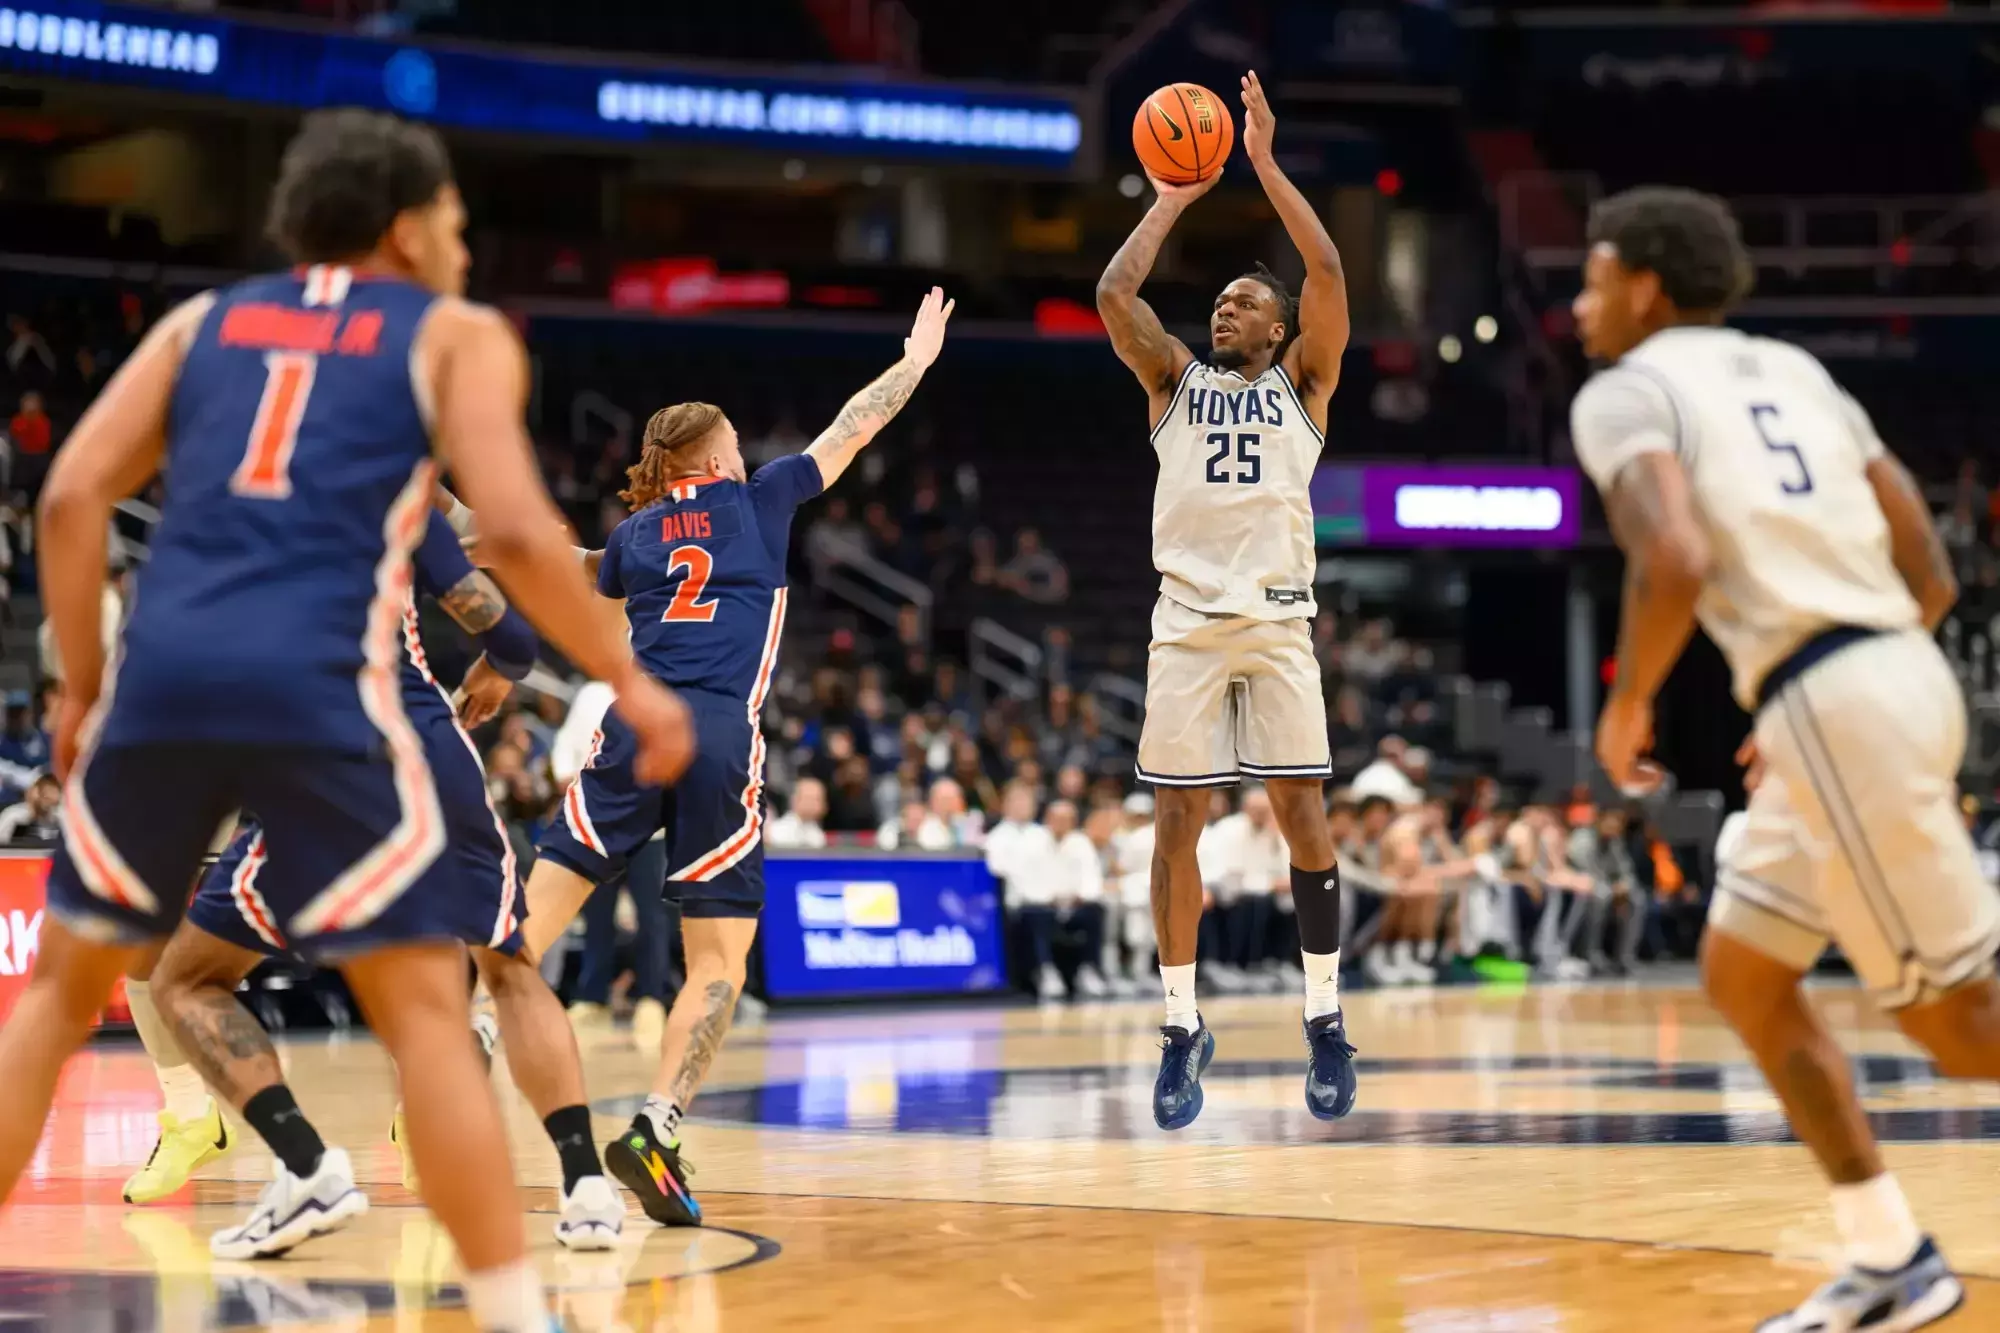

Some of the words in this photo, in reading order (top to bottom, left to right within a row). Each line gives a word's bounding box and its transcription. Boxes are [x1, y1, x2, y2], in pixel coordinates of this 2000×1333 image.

[1185, 88, 1213, 134] ELITE
[228, 348, 319, 500] 1
[1188, 387, 1283, 427] HOYAS
[1206, 432, 1260, 484] 25
[1747, 404, 1814, 494] 5
[660, 511, 712, 542] DAVIS
[660, 544, 720, 624] 2
